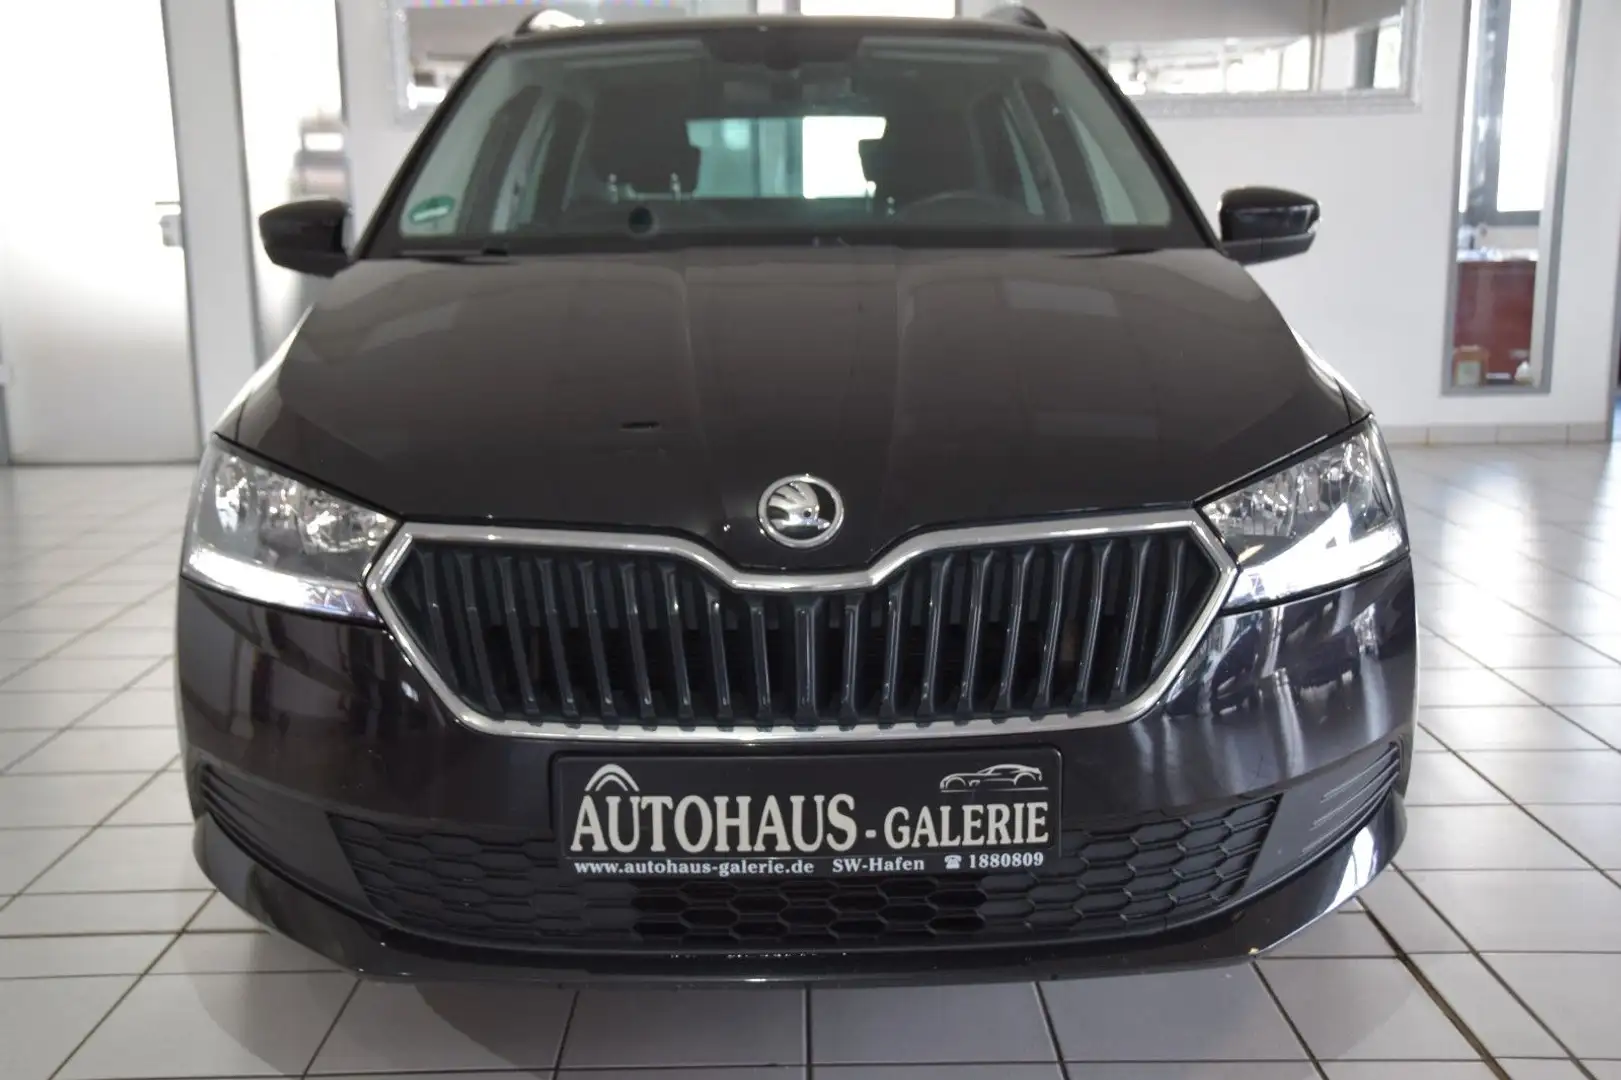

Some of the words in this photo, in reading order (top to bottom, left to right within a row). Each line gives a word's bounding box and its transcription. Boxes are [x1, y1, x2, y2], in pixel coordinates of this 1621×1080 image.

[570, 794, 857, 853] AUTOHAUS
[884, 802, 1049, 849] GALERIE
[574, 858, 815, 876] www.autohaus-galerie.de
[832, 857, 925, 873] SW-Hafen
[968, 851, 1044, 869] 1880809
